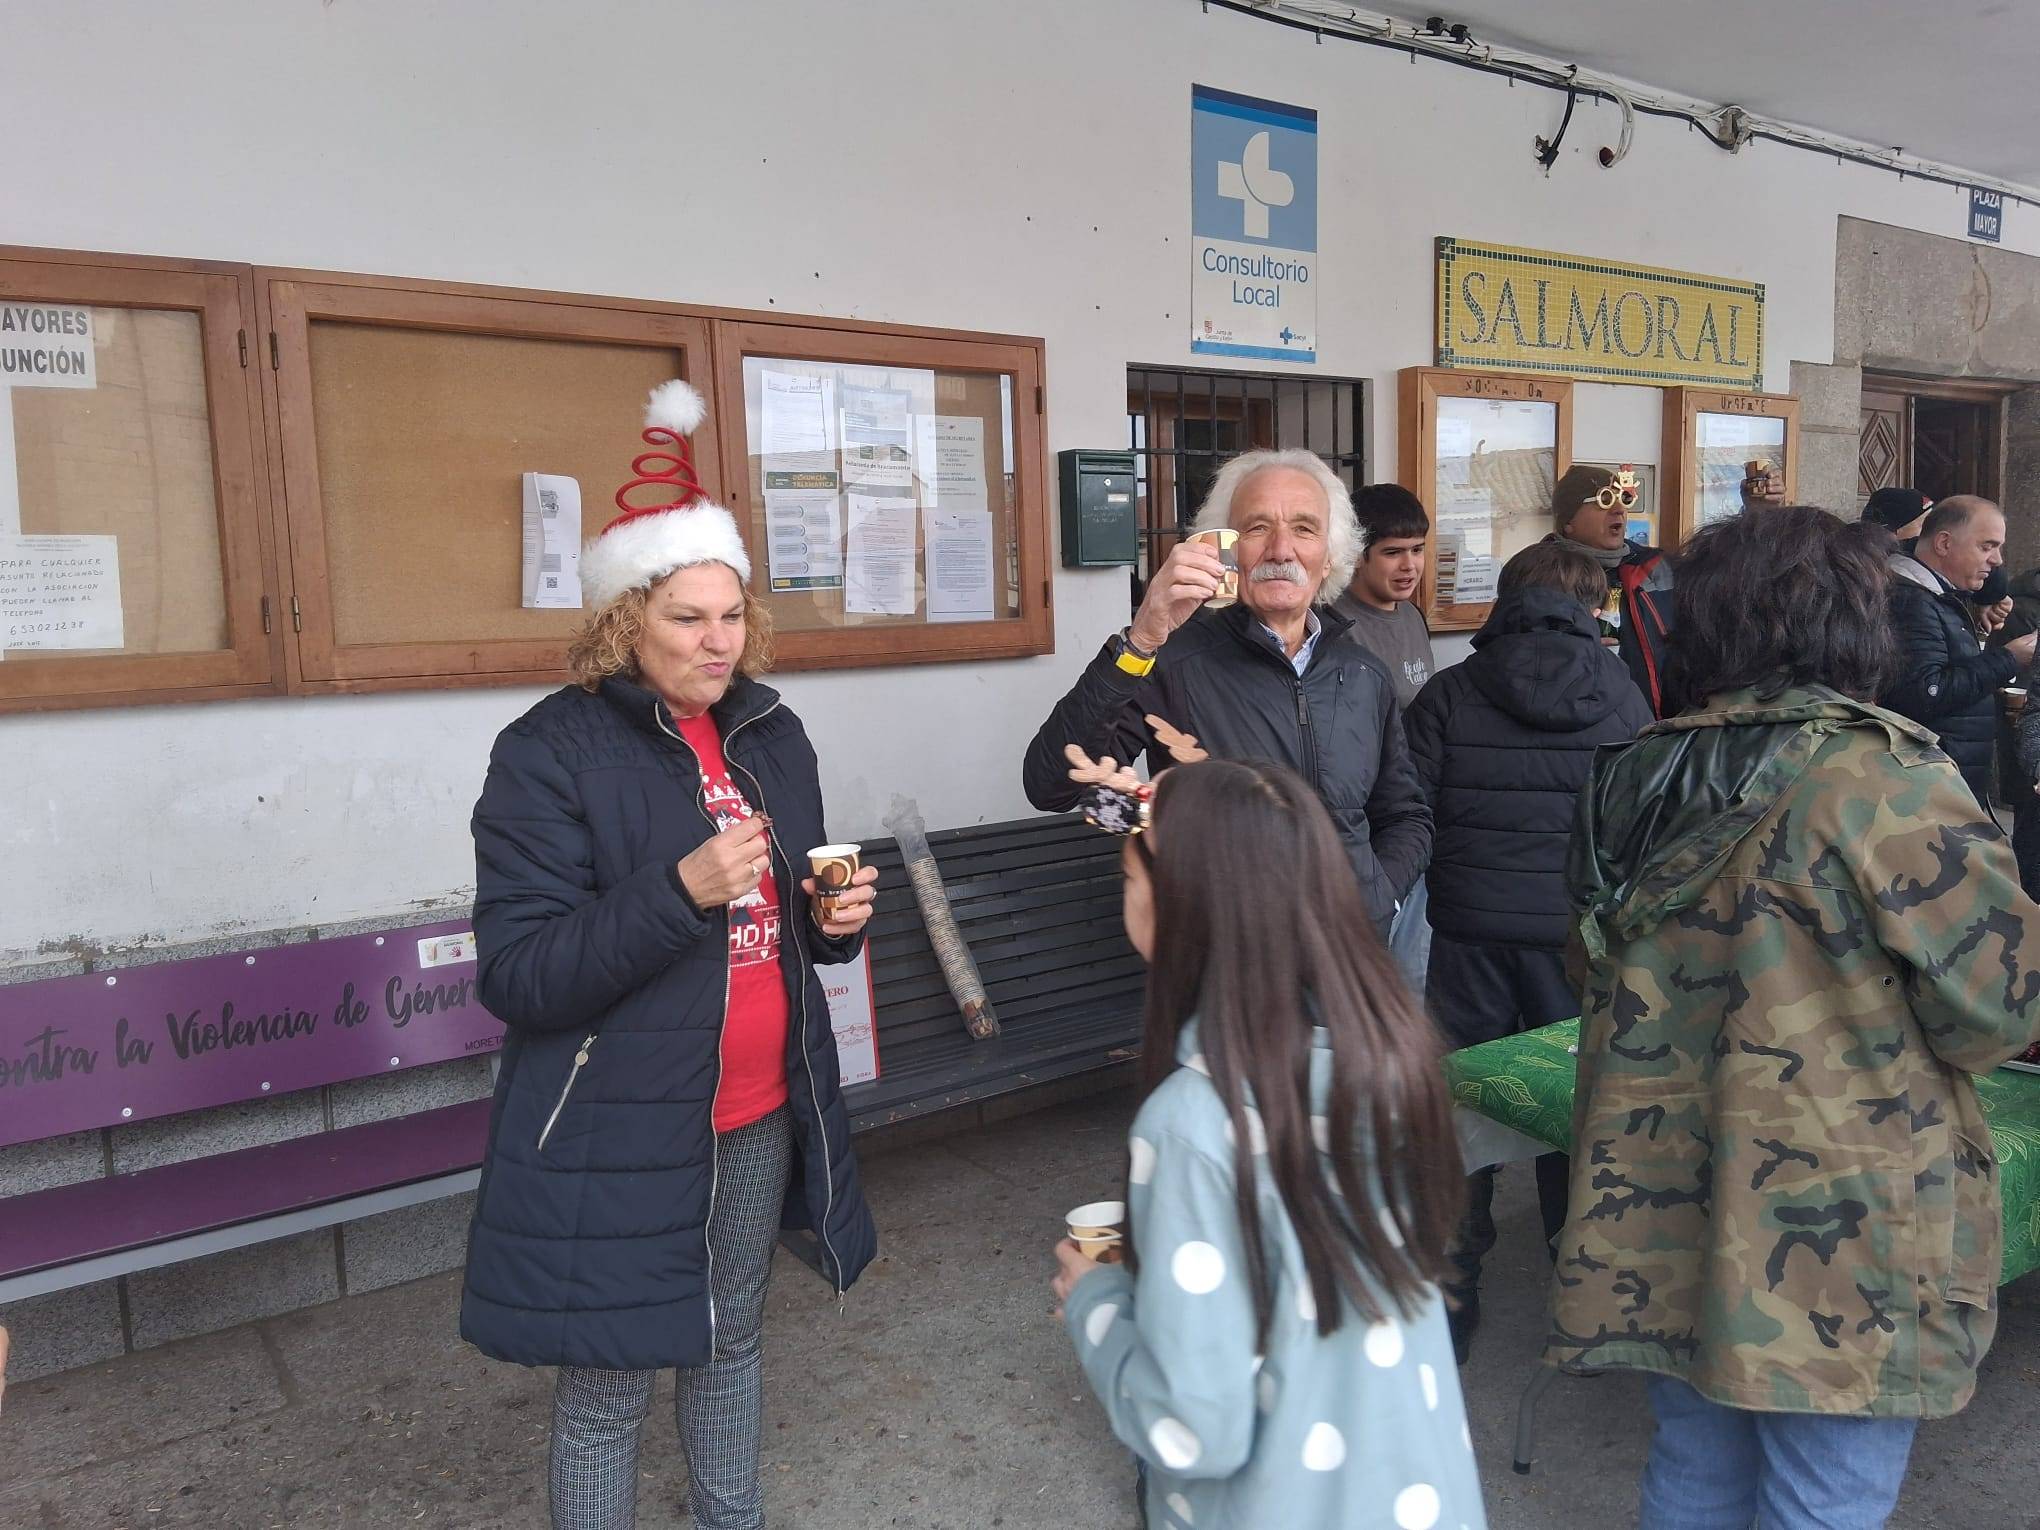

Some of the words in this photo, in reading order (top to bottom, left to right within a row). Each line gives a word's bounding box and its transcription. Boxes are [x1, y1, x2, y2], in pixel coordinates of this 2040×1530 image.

[1974, 190, 2000, 209] PLAZA
[1974, 213, 1998, 235] MAYOR
[1203, 247, 1308, 283] Consultorio
[1233, 280, 1280, 307] Local
[1460, 271, 1749, 367] SALMORAL
[0, 345, 86, 374] UNCIÓN
[0, 559, 32, 568] PARA
[40, 558, 102, 567] CUALQUIER
[827, 985, 849, 998] ERO
[0, 1026, 99, 1088] ontra
[114, 1017, 155, 1068] la
[166, 1000, 319, 1060] Violencia
[333, 982, 371, 1025] de
[384, 975, 478, 1029] Géner
[464, 1036, 506, 1051] MORET
